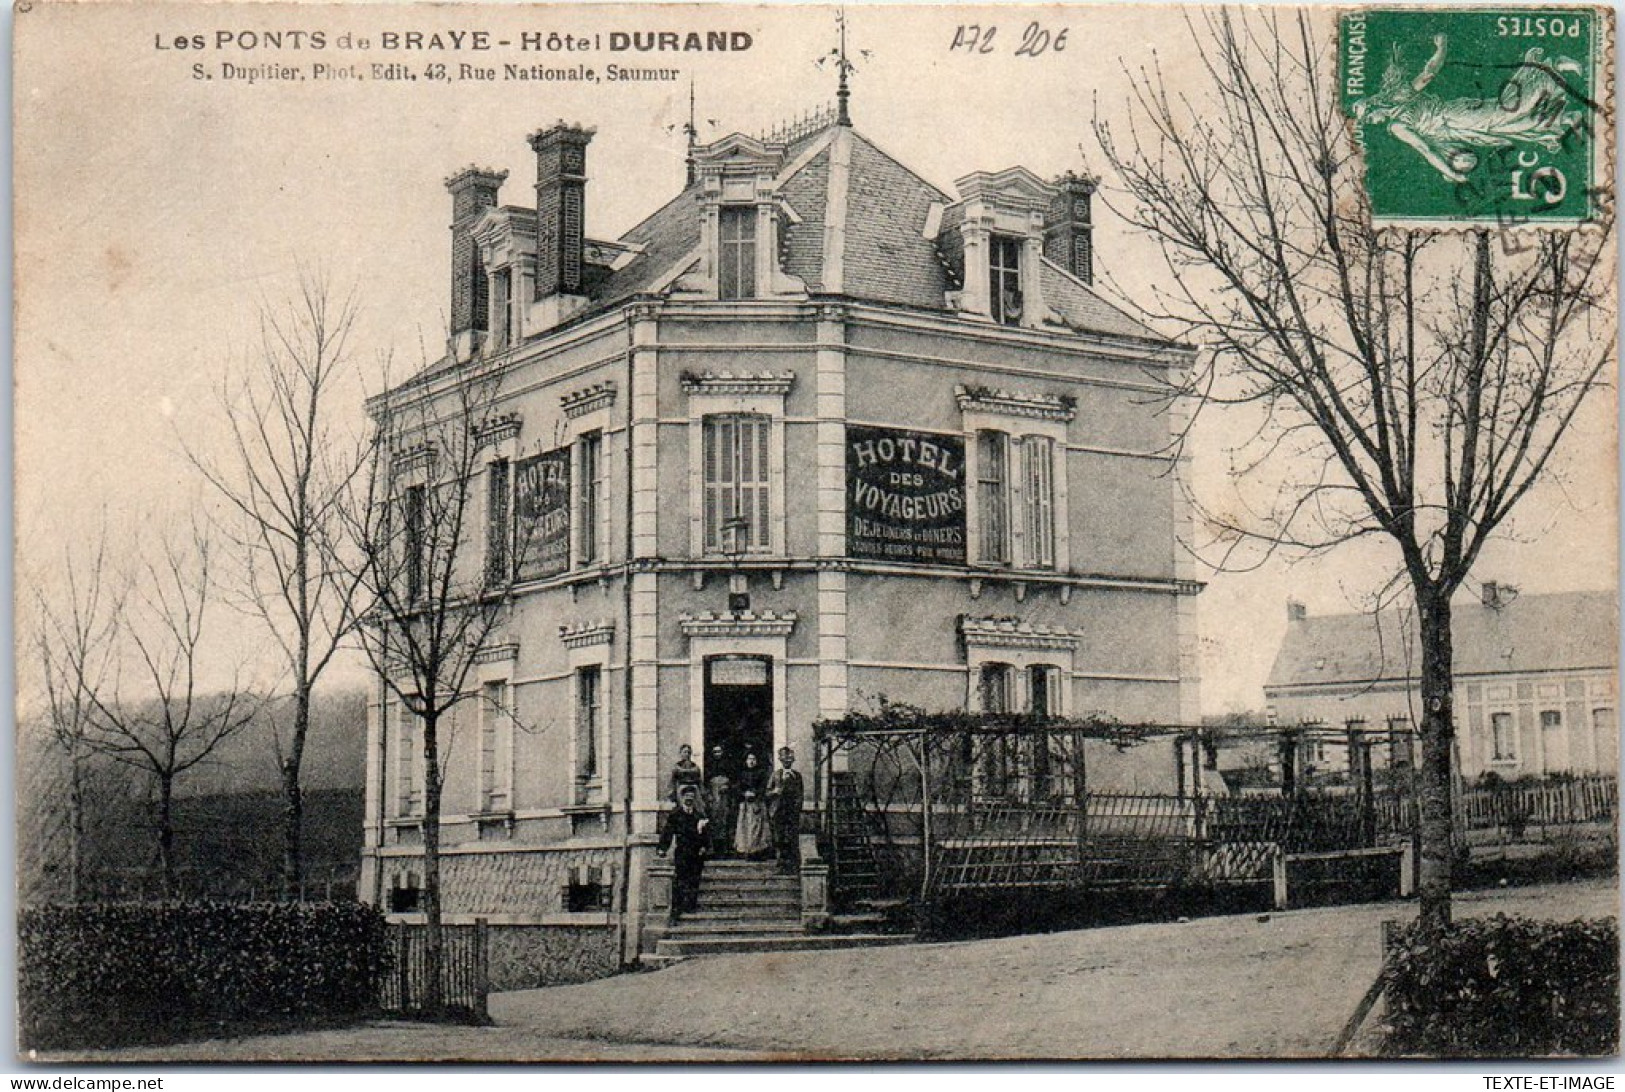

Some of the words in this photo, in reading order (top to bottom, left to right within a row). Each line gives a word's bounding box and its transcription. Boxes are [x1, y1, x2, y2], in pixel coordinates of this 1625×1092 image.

[1497, 16, 1580, 38] POSTES
[155, 32, 206, 50] Les
[215, 31, 327, 50] PONTS
[337, 31, 371, 50] de
[382, 31, 491, 50] BRAYE
[520, 31, 601, 51] Hôtel
[609, 31, 754, 51] DURAND
[1347, 11, 1369, 96] FRANÇAISE
[192, 63, 213, 80] S.
[370, 62, 417, 80] Edit.
[423, 63, 452, 83] 43,
[458, 63, 496, 81] Rue
[504, 62, 601, 83] Nationale,
[606, 63, 681, 81] Saumur
[853, 437, 957, 479] HOTEL
[890, 471, 924, 487] DES
[855, 478, 962, 519] VOYAGEURS
